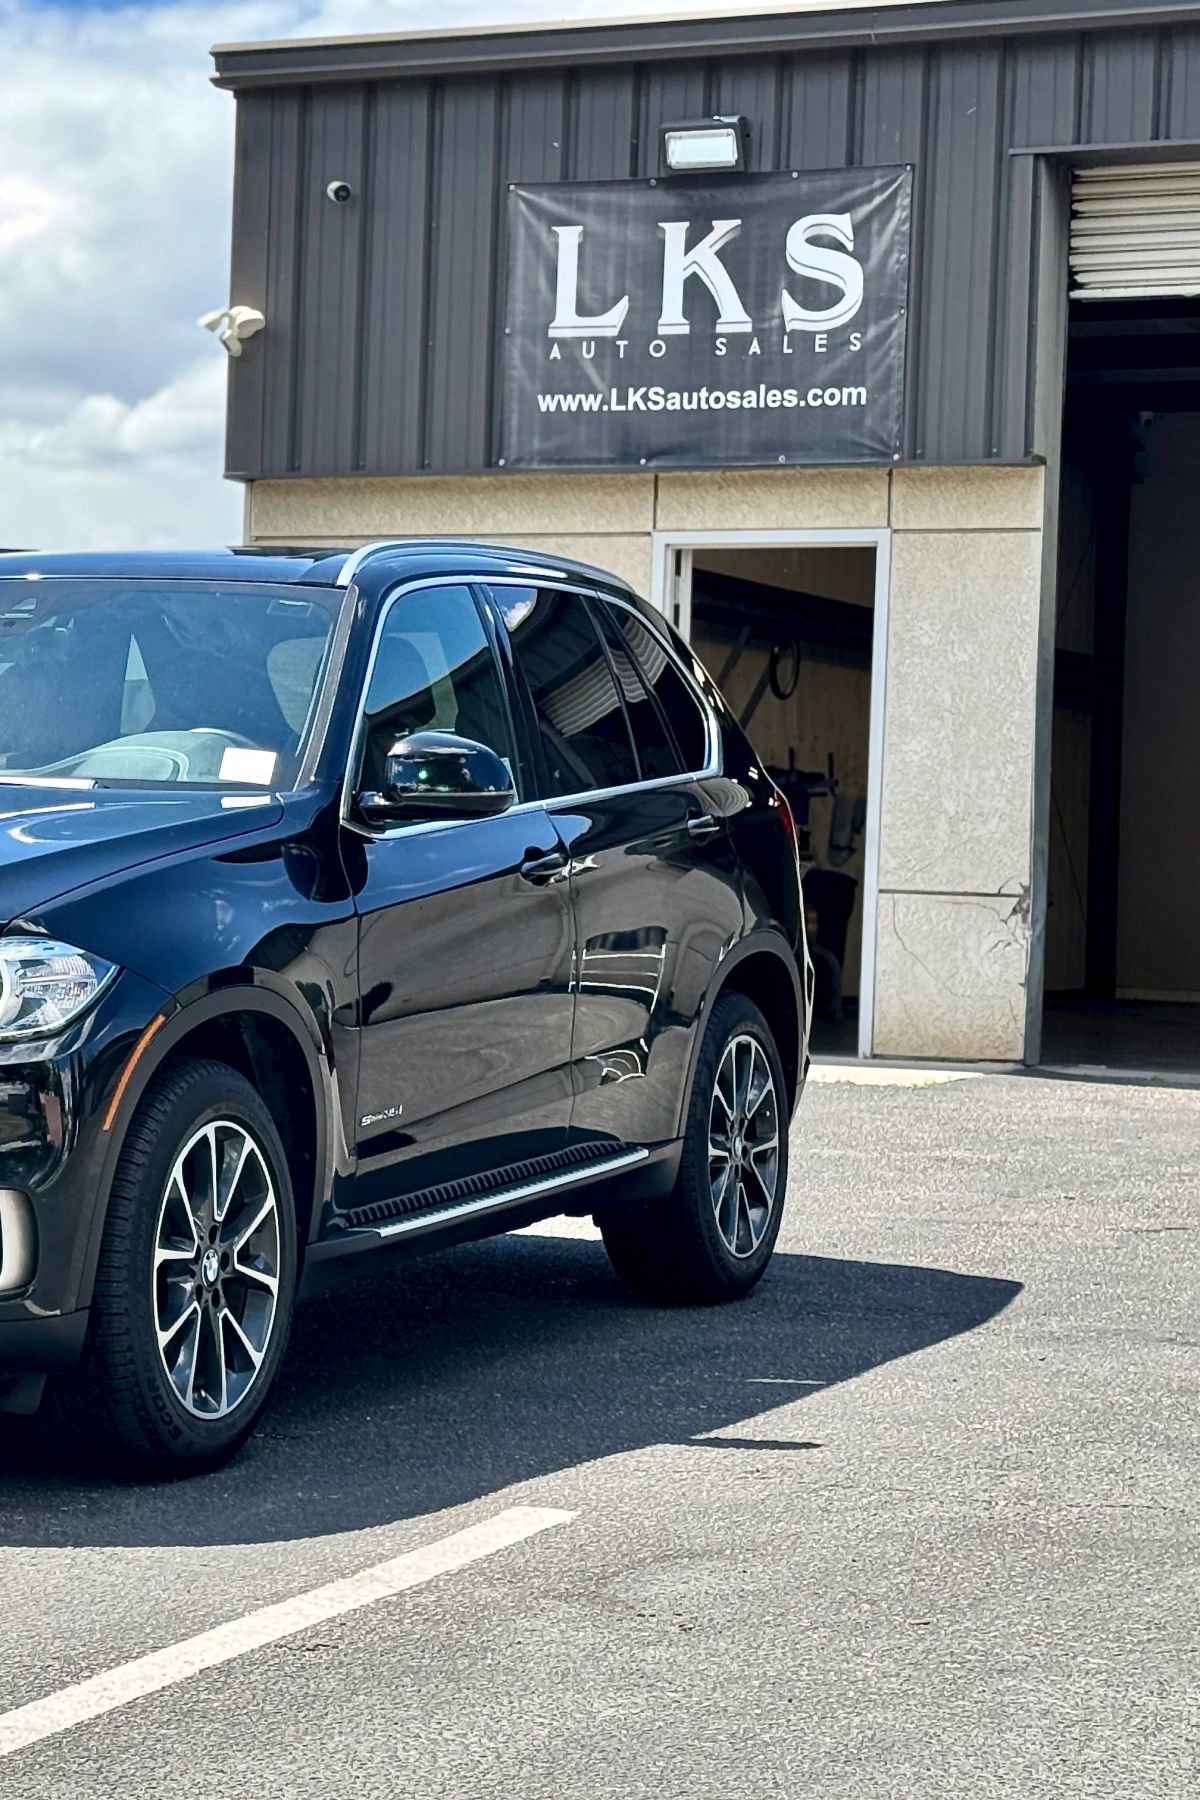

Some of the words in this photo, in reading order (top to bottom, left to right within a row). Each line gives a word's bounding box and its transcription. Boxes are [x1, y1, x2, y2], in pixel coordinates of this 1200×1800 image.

[548, 213, 864, 338] LKS
[549, 340, 667, 360] AUTO
[715, 333, 862, 357] SALES
[538, 384, 867, 413] www.LKSautosales.com
